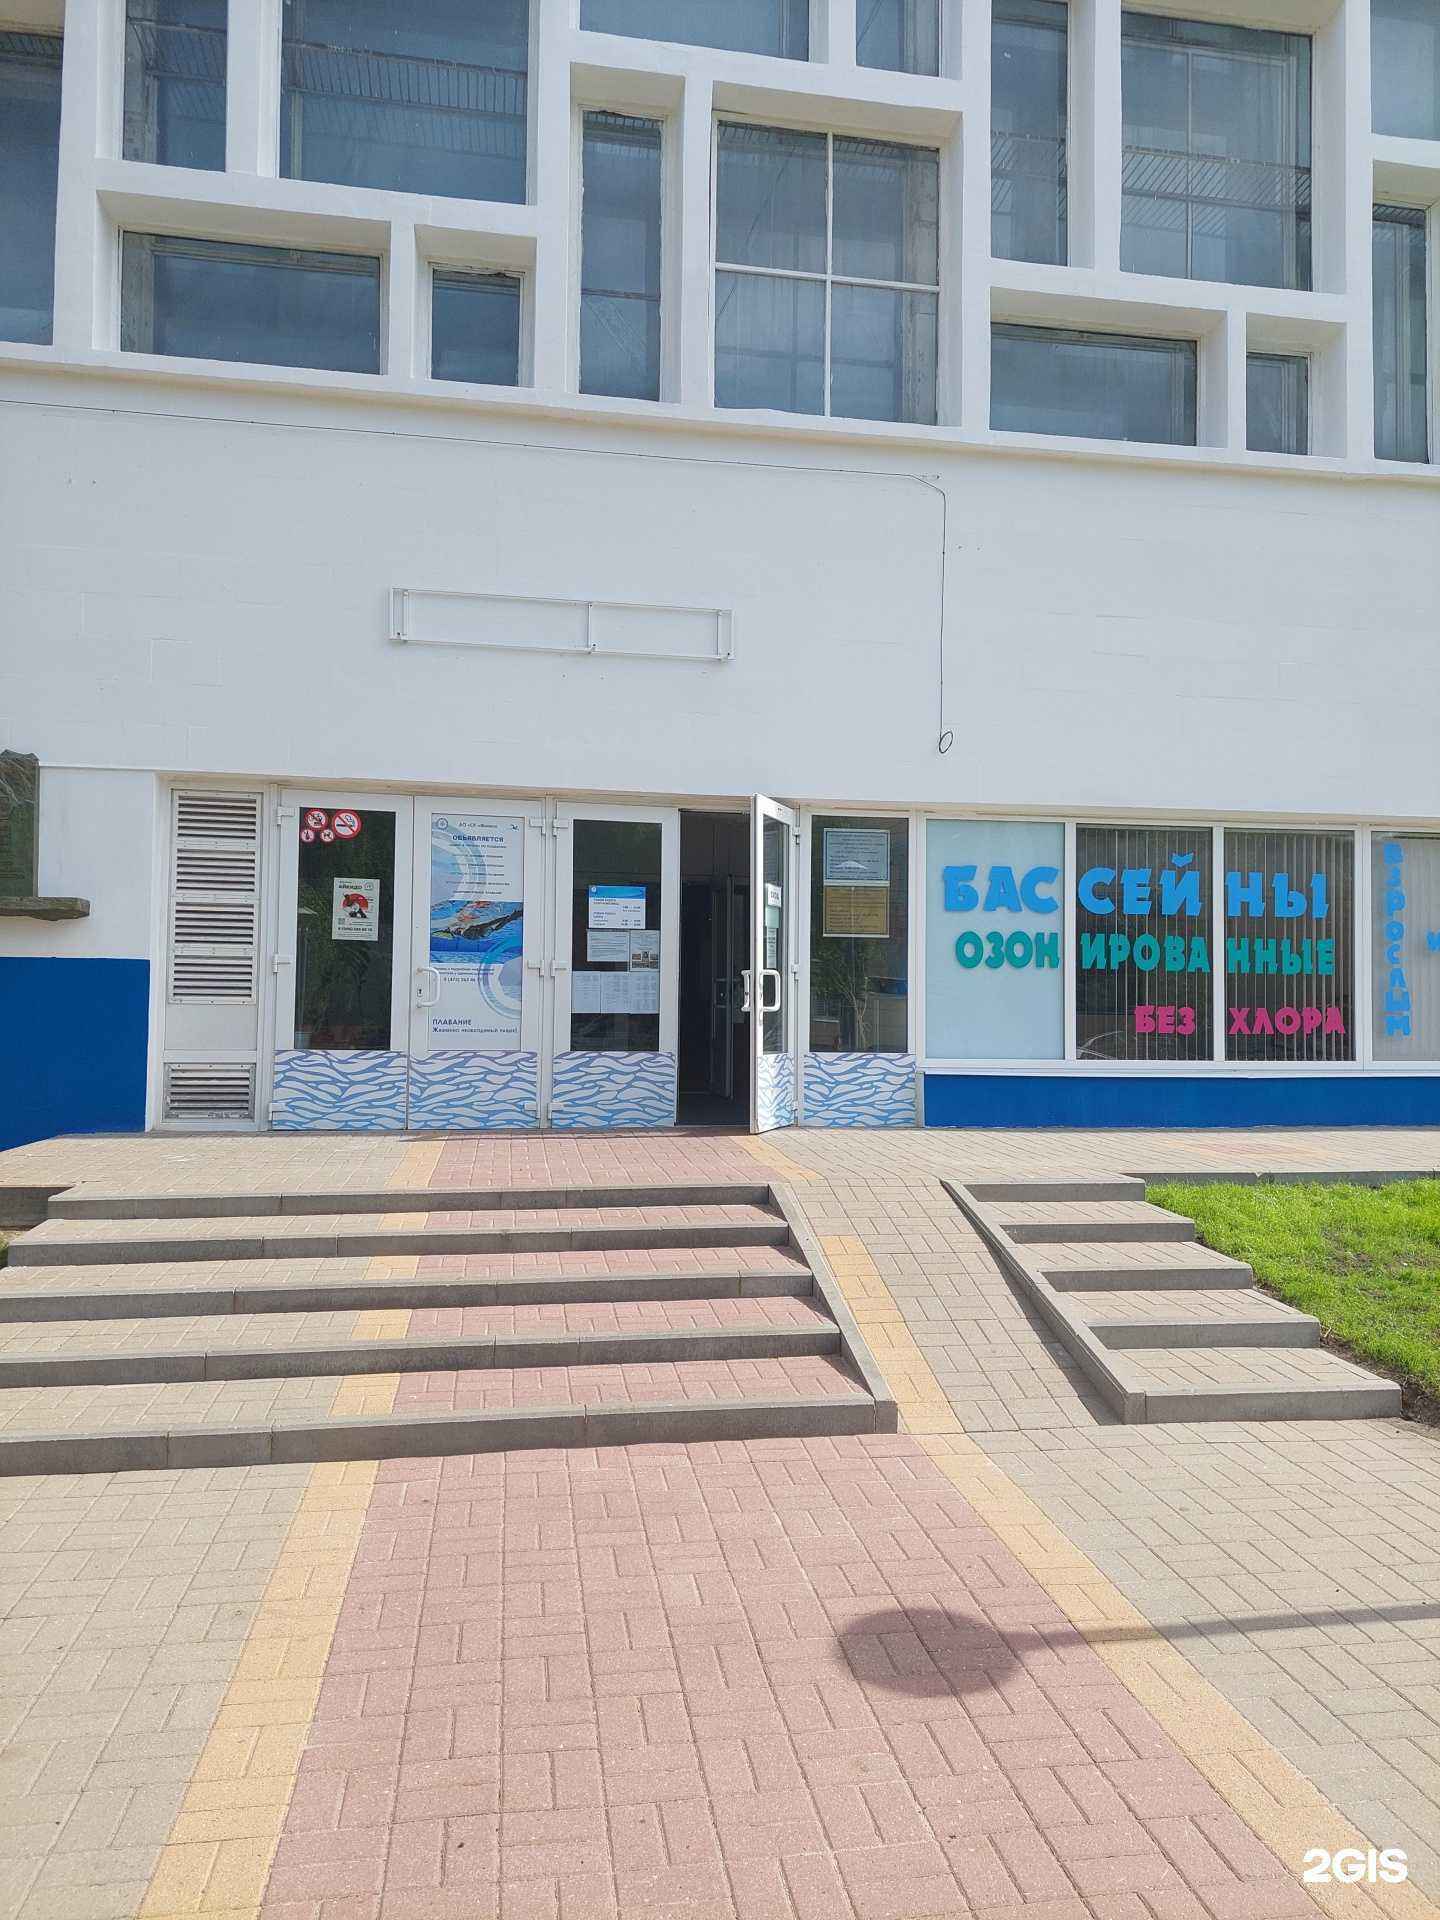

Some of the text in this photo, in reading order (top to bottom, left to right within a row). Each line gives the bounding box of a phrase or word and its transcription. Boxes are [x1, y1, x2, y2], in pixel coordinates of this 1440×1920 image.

[452, 834, 504, 842] ОБЪЯВЛЯЕТСЯ
[942, 852, 1329, 919] БАССЕЙНЫ
[955, 930, 1335, 976] ОЗОНИРОВАННЫЕ
[432, 1018, 472, 1026] ПЛАВАНИЕ
[1134, 1004, 1346, 1037] БЕЗ ХЛОРА
